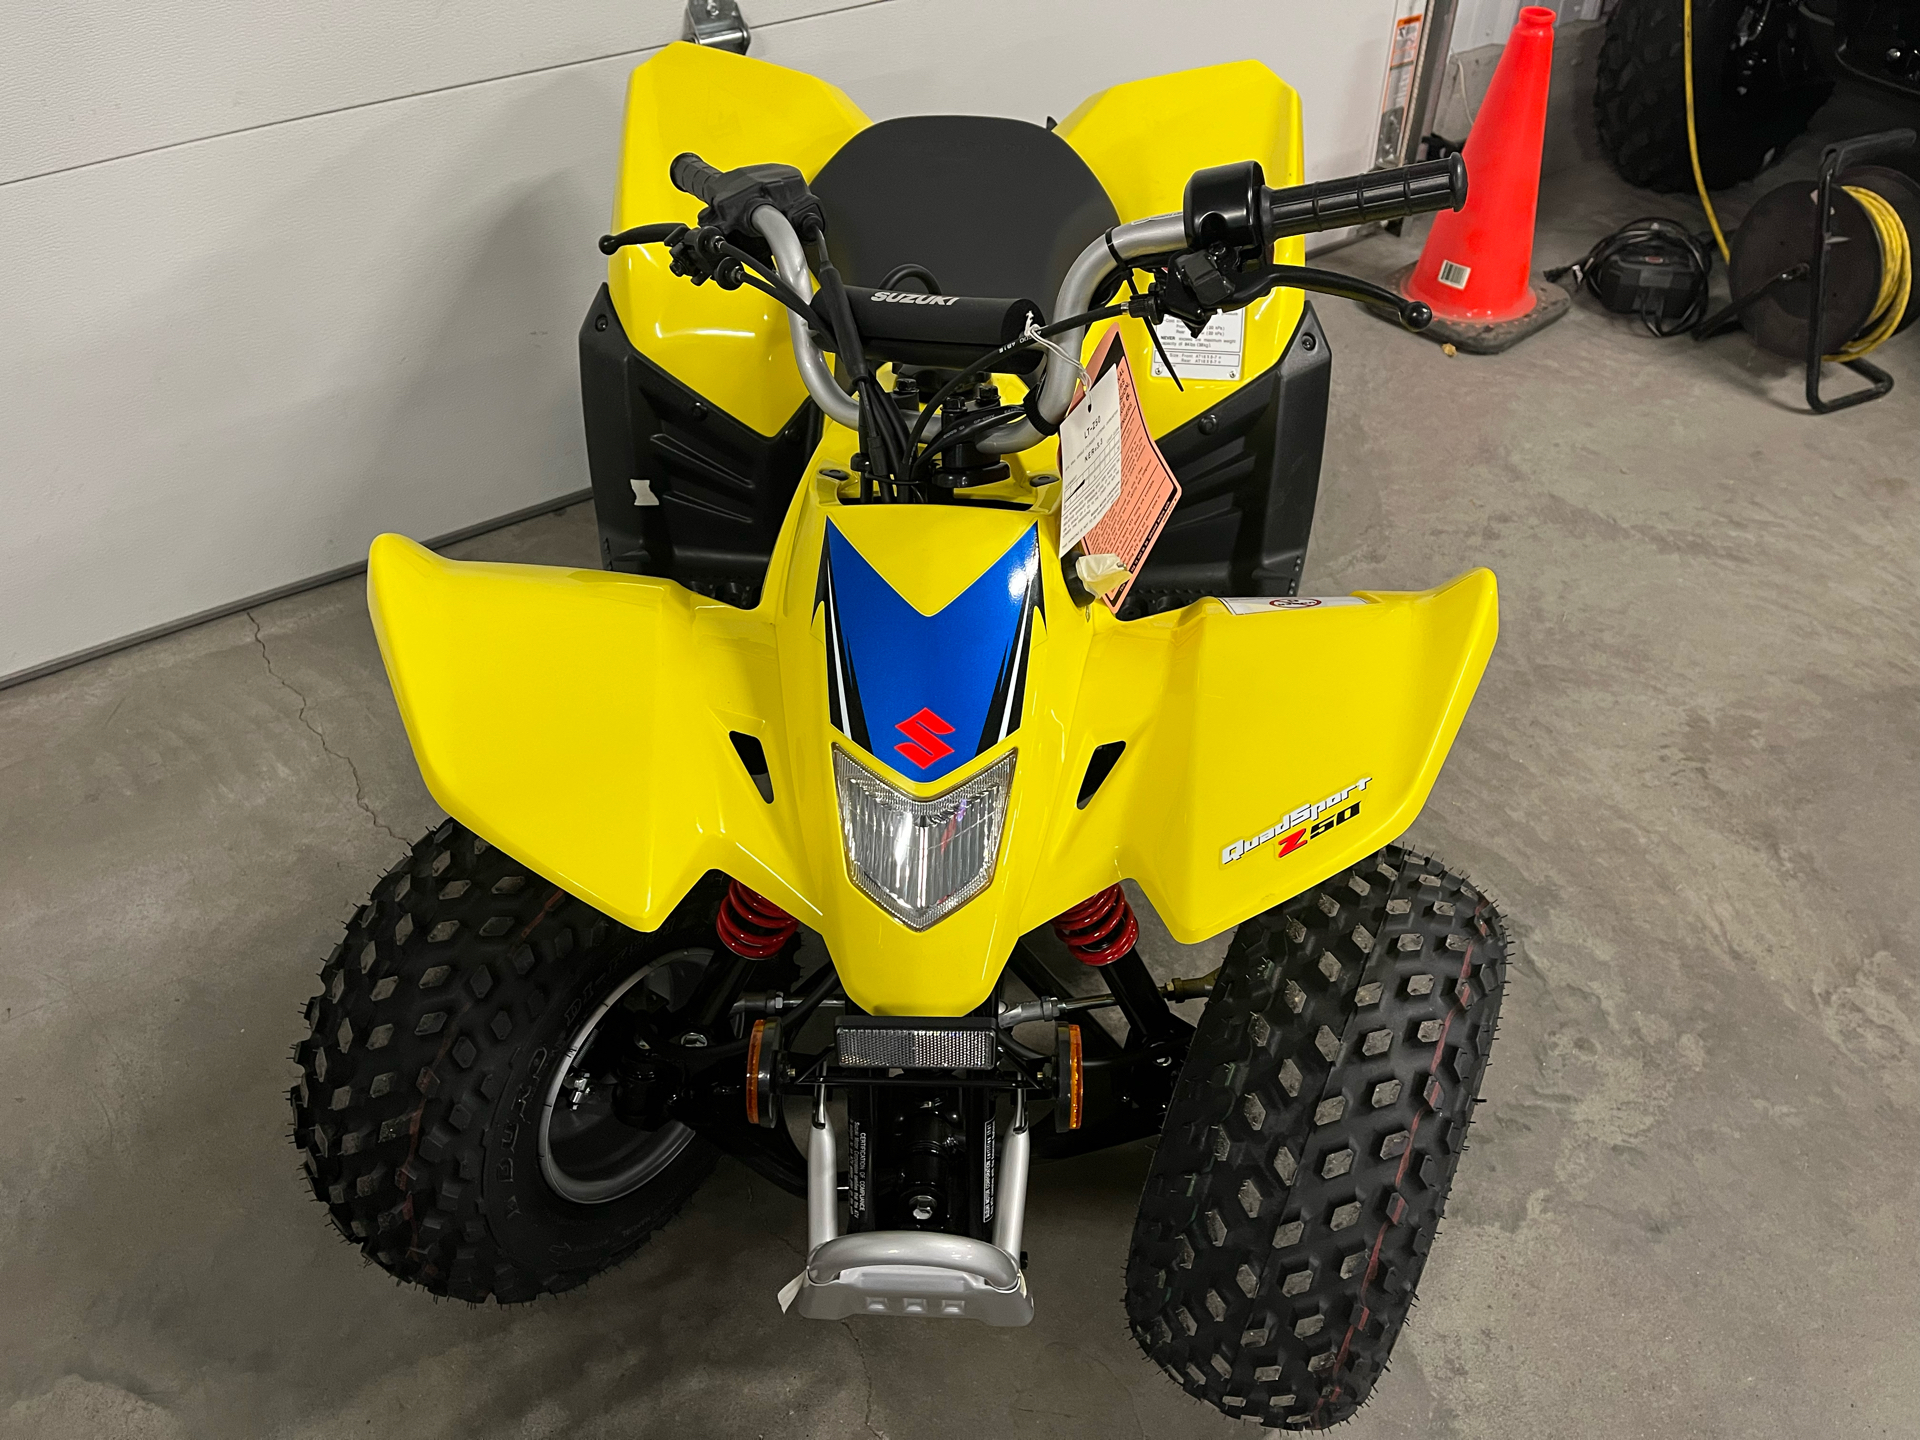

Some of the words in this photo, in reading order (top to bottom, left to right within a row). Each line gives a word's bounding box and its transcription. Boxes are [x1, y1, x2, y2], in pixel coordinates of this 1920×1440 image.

[871, 291, 960, 306] SUZUKI
[1221, 776, 1373, 865] QuadSport
[1278, 800, 1362, 859] Z50
